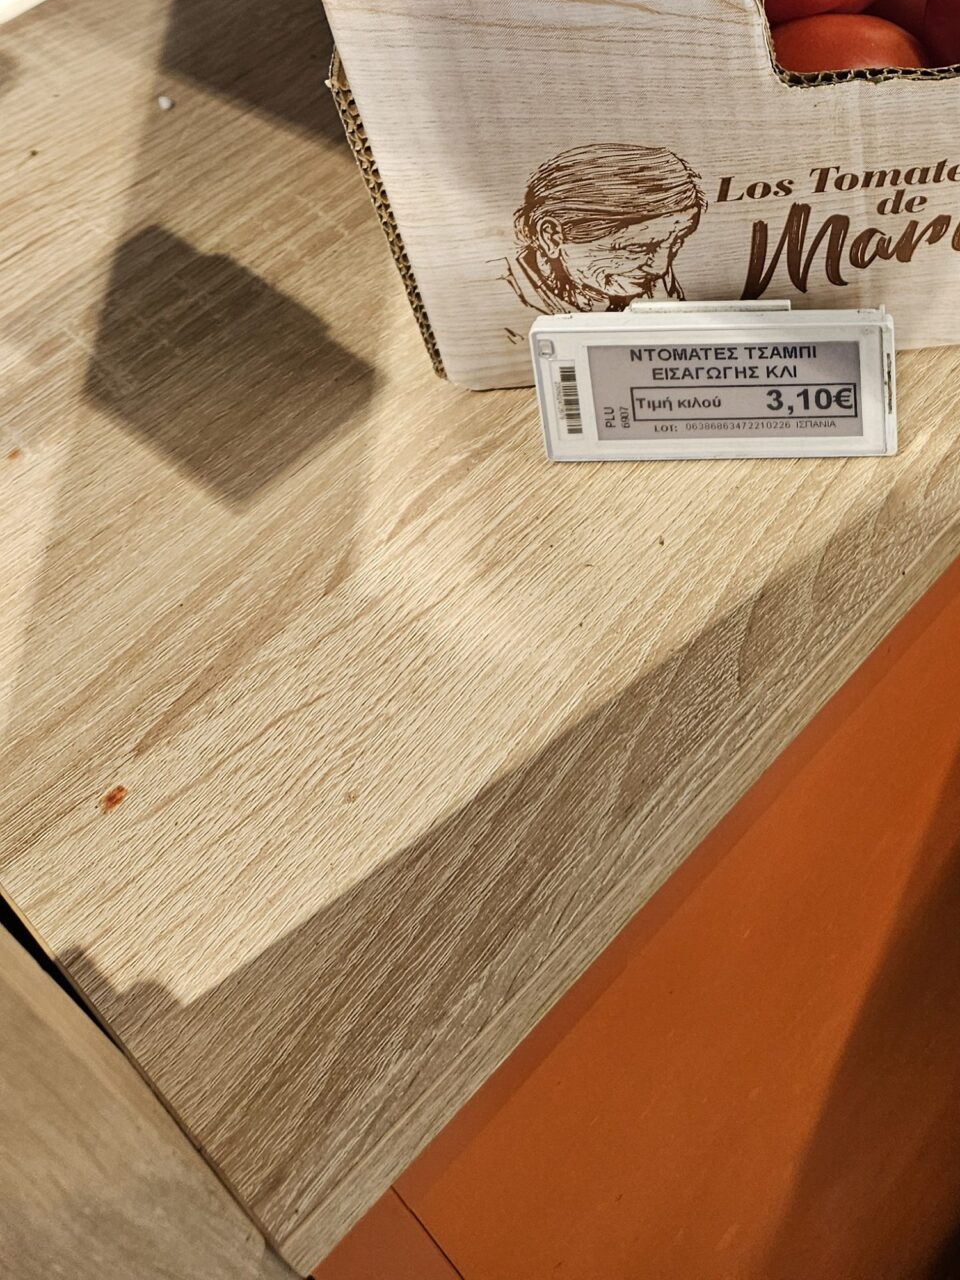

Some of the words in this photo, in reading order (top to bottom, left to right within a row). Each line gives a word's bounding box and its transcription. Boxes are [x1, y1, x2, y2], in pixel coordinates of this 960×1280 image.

[715, 175, 795, 203] Los
[876, 188, 928, 215] de
[630, 347, 738, 362] ΝΤΟΜΑΤΕΣ
[744, 345, 817, 360] ΤΣΑΜΠΙ
[652, 366, 759, 380] ΕΙΣΑΓΩΓΗΣ
[766, 365, 798, 379] ΚΛΙ
[636, 396, 672, 412] Τιμή
[677, 396, 722, 409] κιλού
[766, 387, 853, 415] 3,10€
[603, 406, 616, 428] PLU
[796, 419, 837, 430] ΙΣΠΑΝΙΑ
